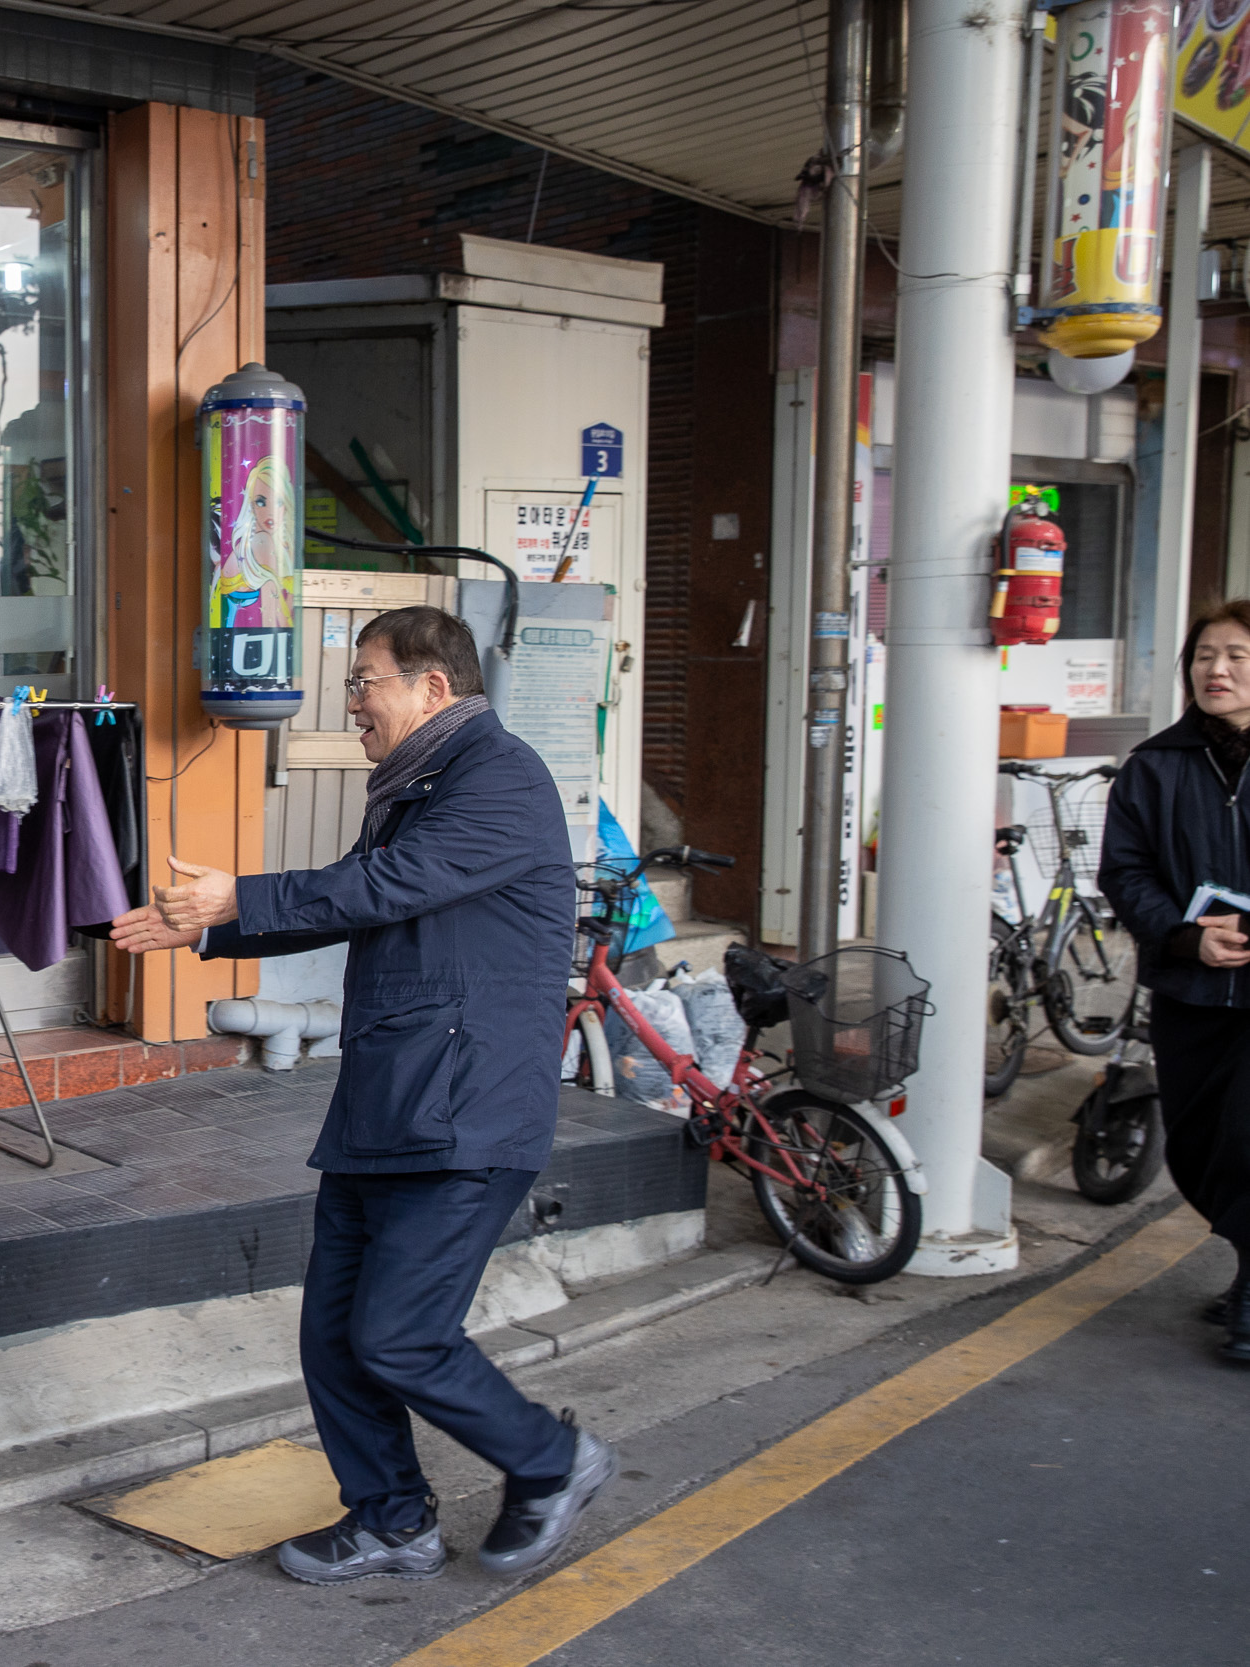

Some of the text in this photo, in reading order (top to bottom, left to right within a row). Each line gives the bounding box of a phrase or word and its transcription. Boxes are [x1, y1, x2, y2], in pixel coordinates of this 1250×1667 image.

[596, 450, 609, 473] 3
[517, 506, 566, 527] 모아타운
[232, 632, 288, 685] 미
